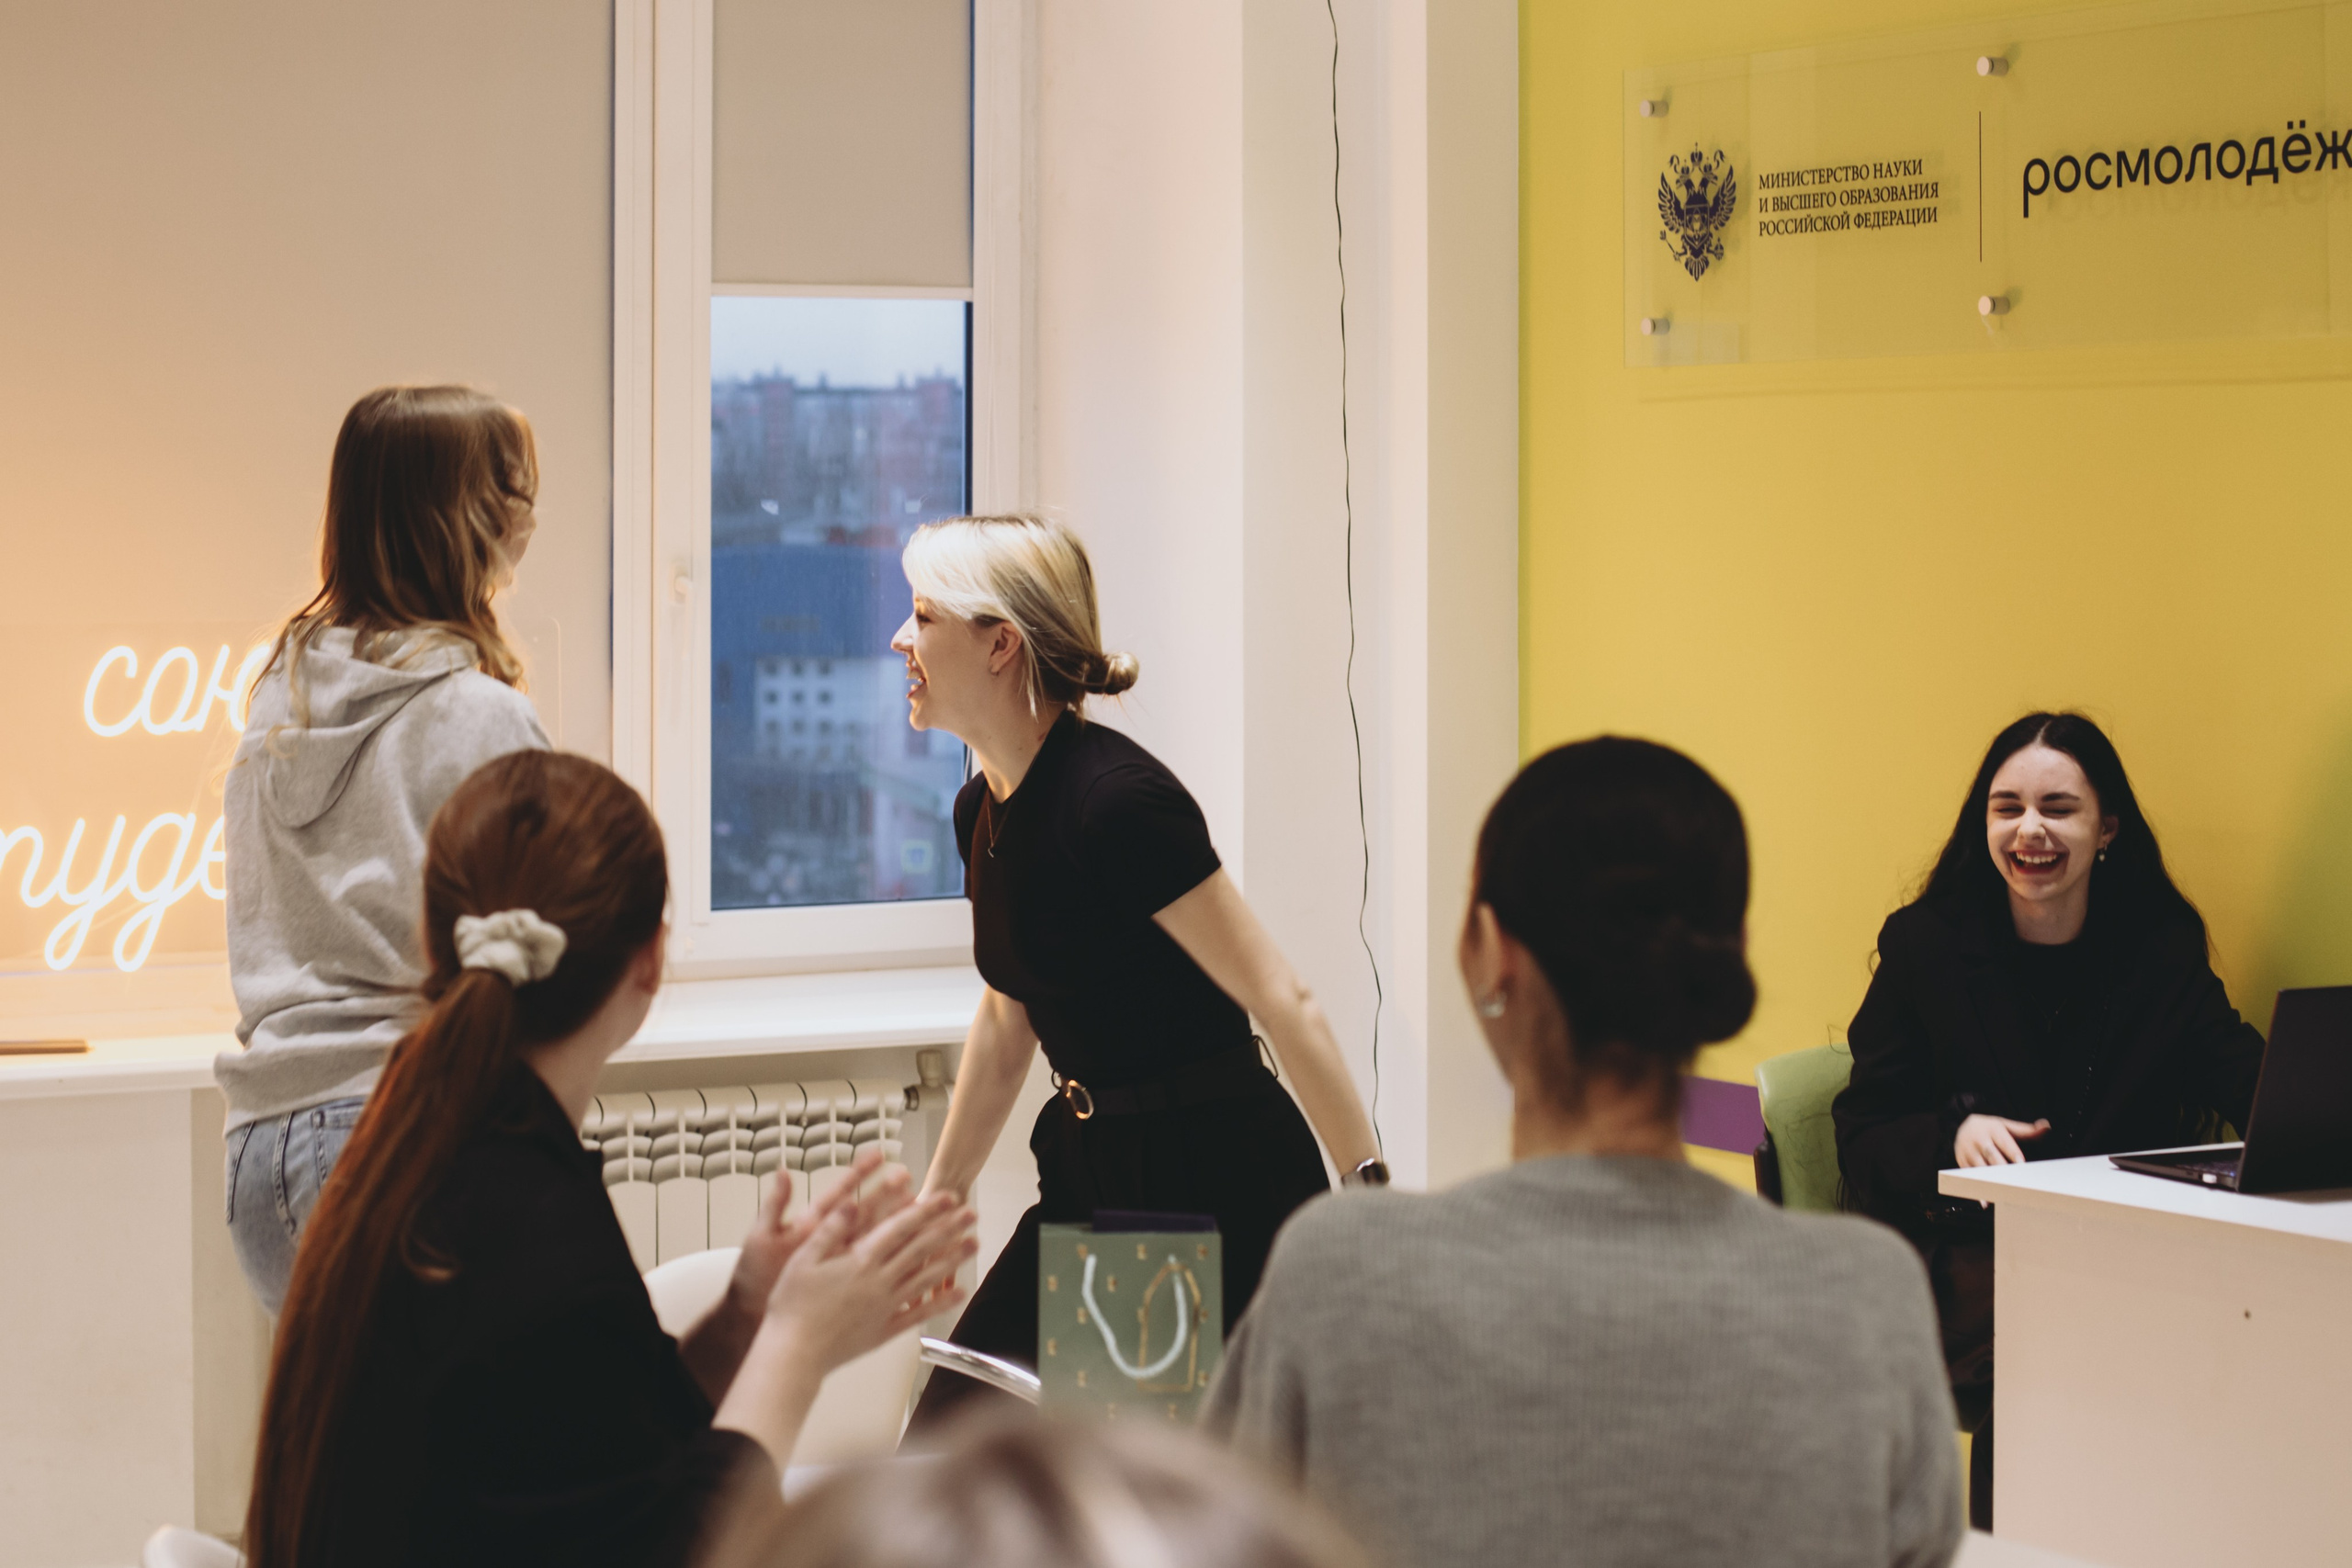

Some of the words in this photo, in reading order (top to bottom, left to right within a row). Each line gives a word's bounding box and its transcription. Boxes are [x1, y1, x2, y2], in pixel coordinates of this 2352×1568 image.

[1758, 164, 1870, 190] МИНИСТЕРСТВО
[1872, 159, 1923, 180] НАУКИ
[1758, 197, 1769, 213] И
[1771, 191, 1837, 212] ВЫСШЕГО
[1839, 182, 1939, 207] ОБРАЗОВАНИЯ
[1758, 210, 1850, 237] РОССИЙСКОЙ
[1853, 207, 1938, 231] ФЕДЕРАЦИИ
